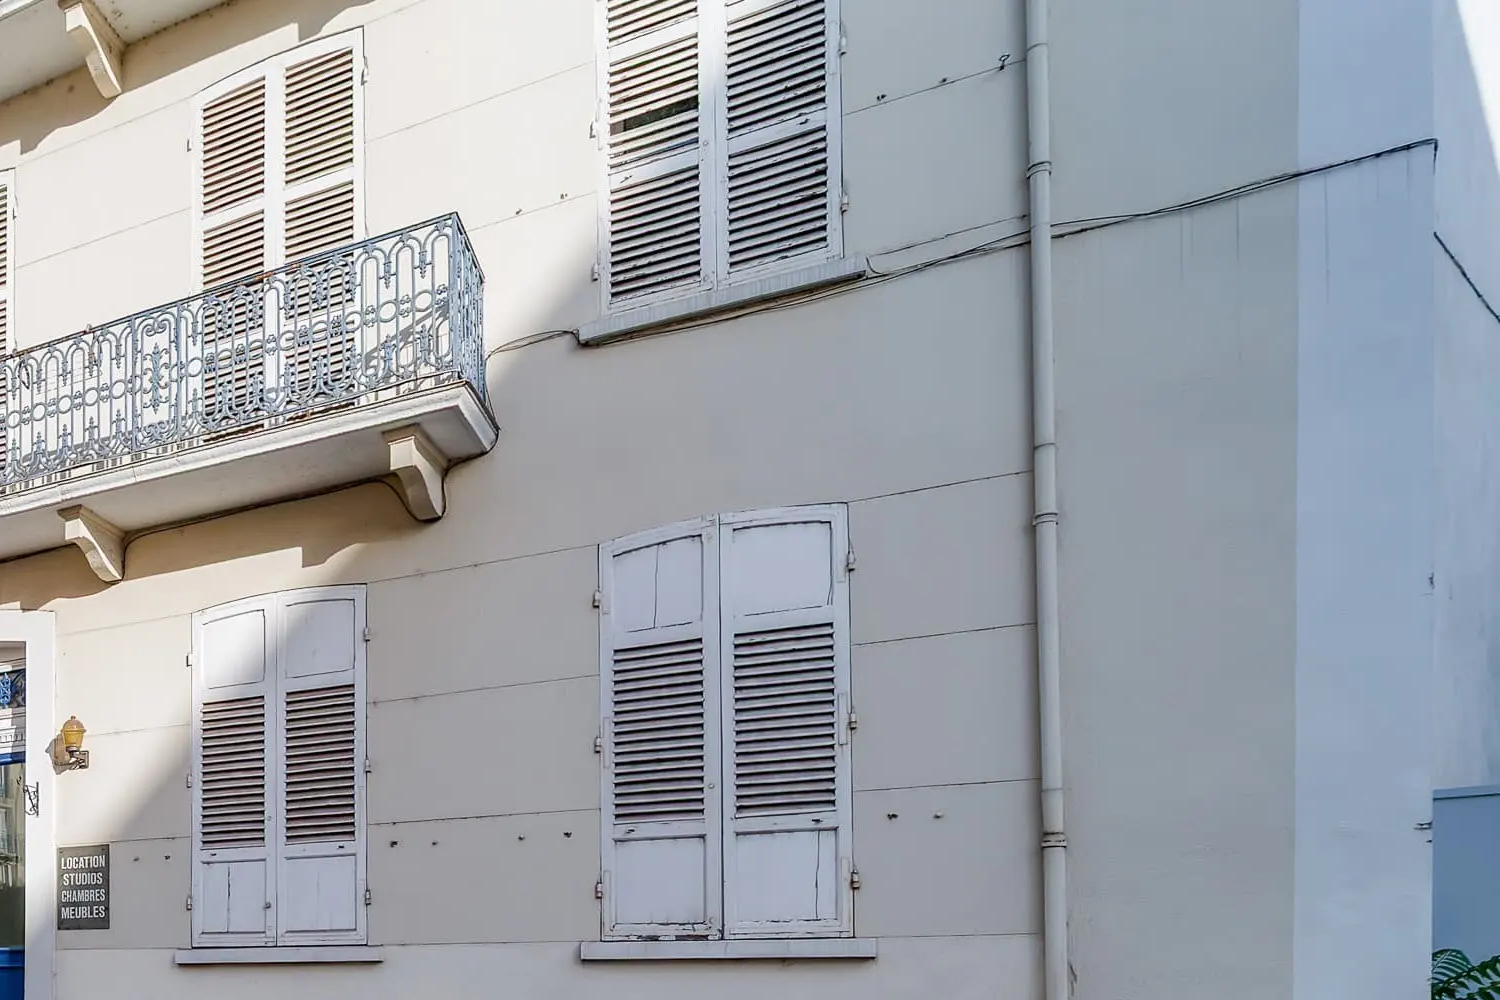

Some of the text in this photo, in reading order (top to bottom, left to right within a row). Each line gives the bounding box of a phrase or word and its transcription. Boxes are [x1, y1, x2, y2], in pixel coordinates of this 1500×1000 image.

[61, 855, 106, 870] LOCATION
[63, 872, 103, 886] STUDIOS
[61, 889, 106, 903] CHAMBRES
[61, 905, 106, 919] MEUBLES
